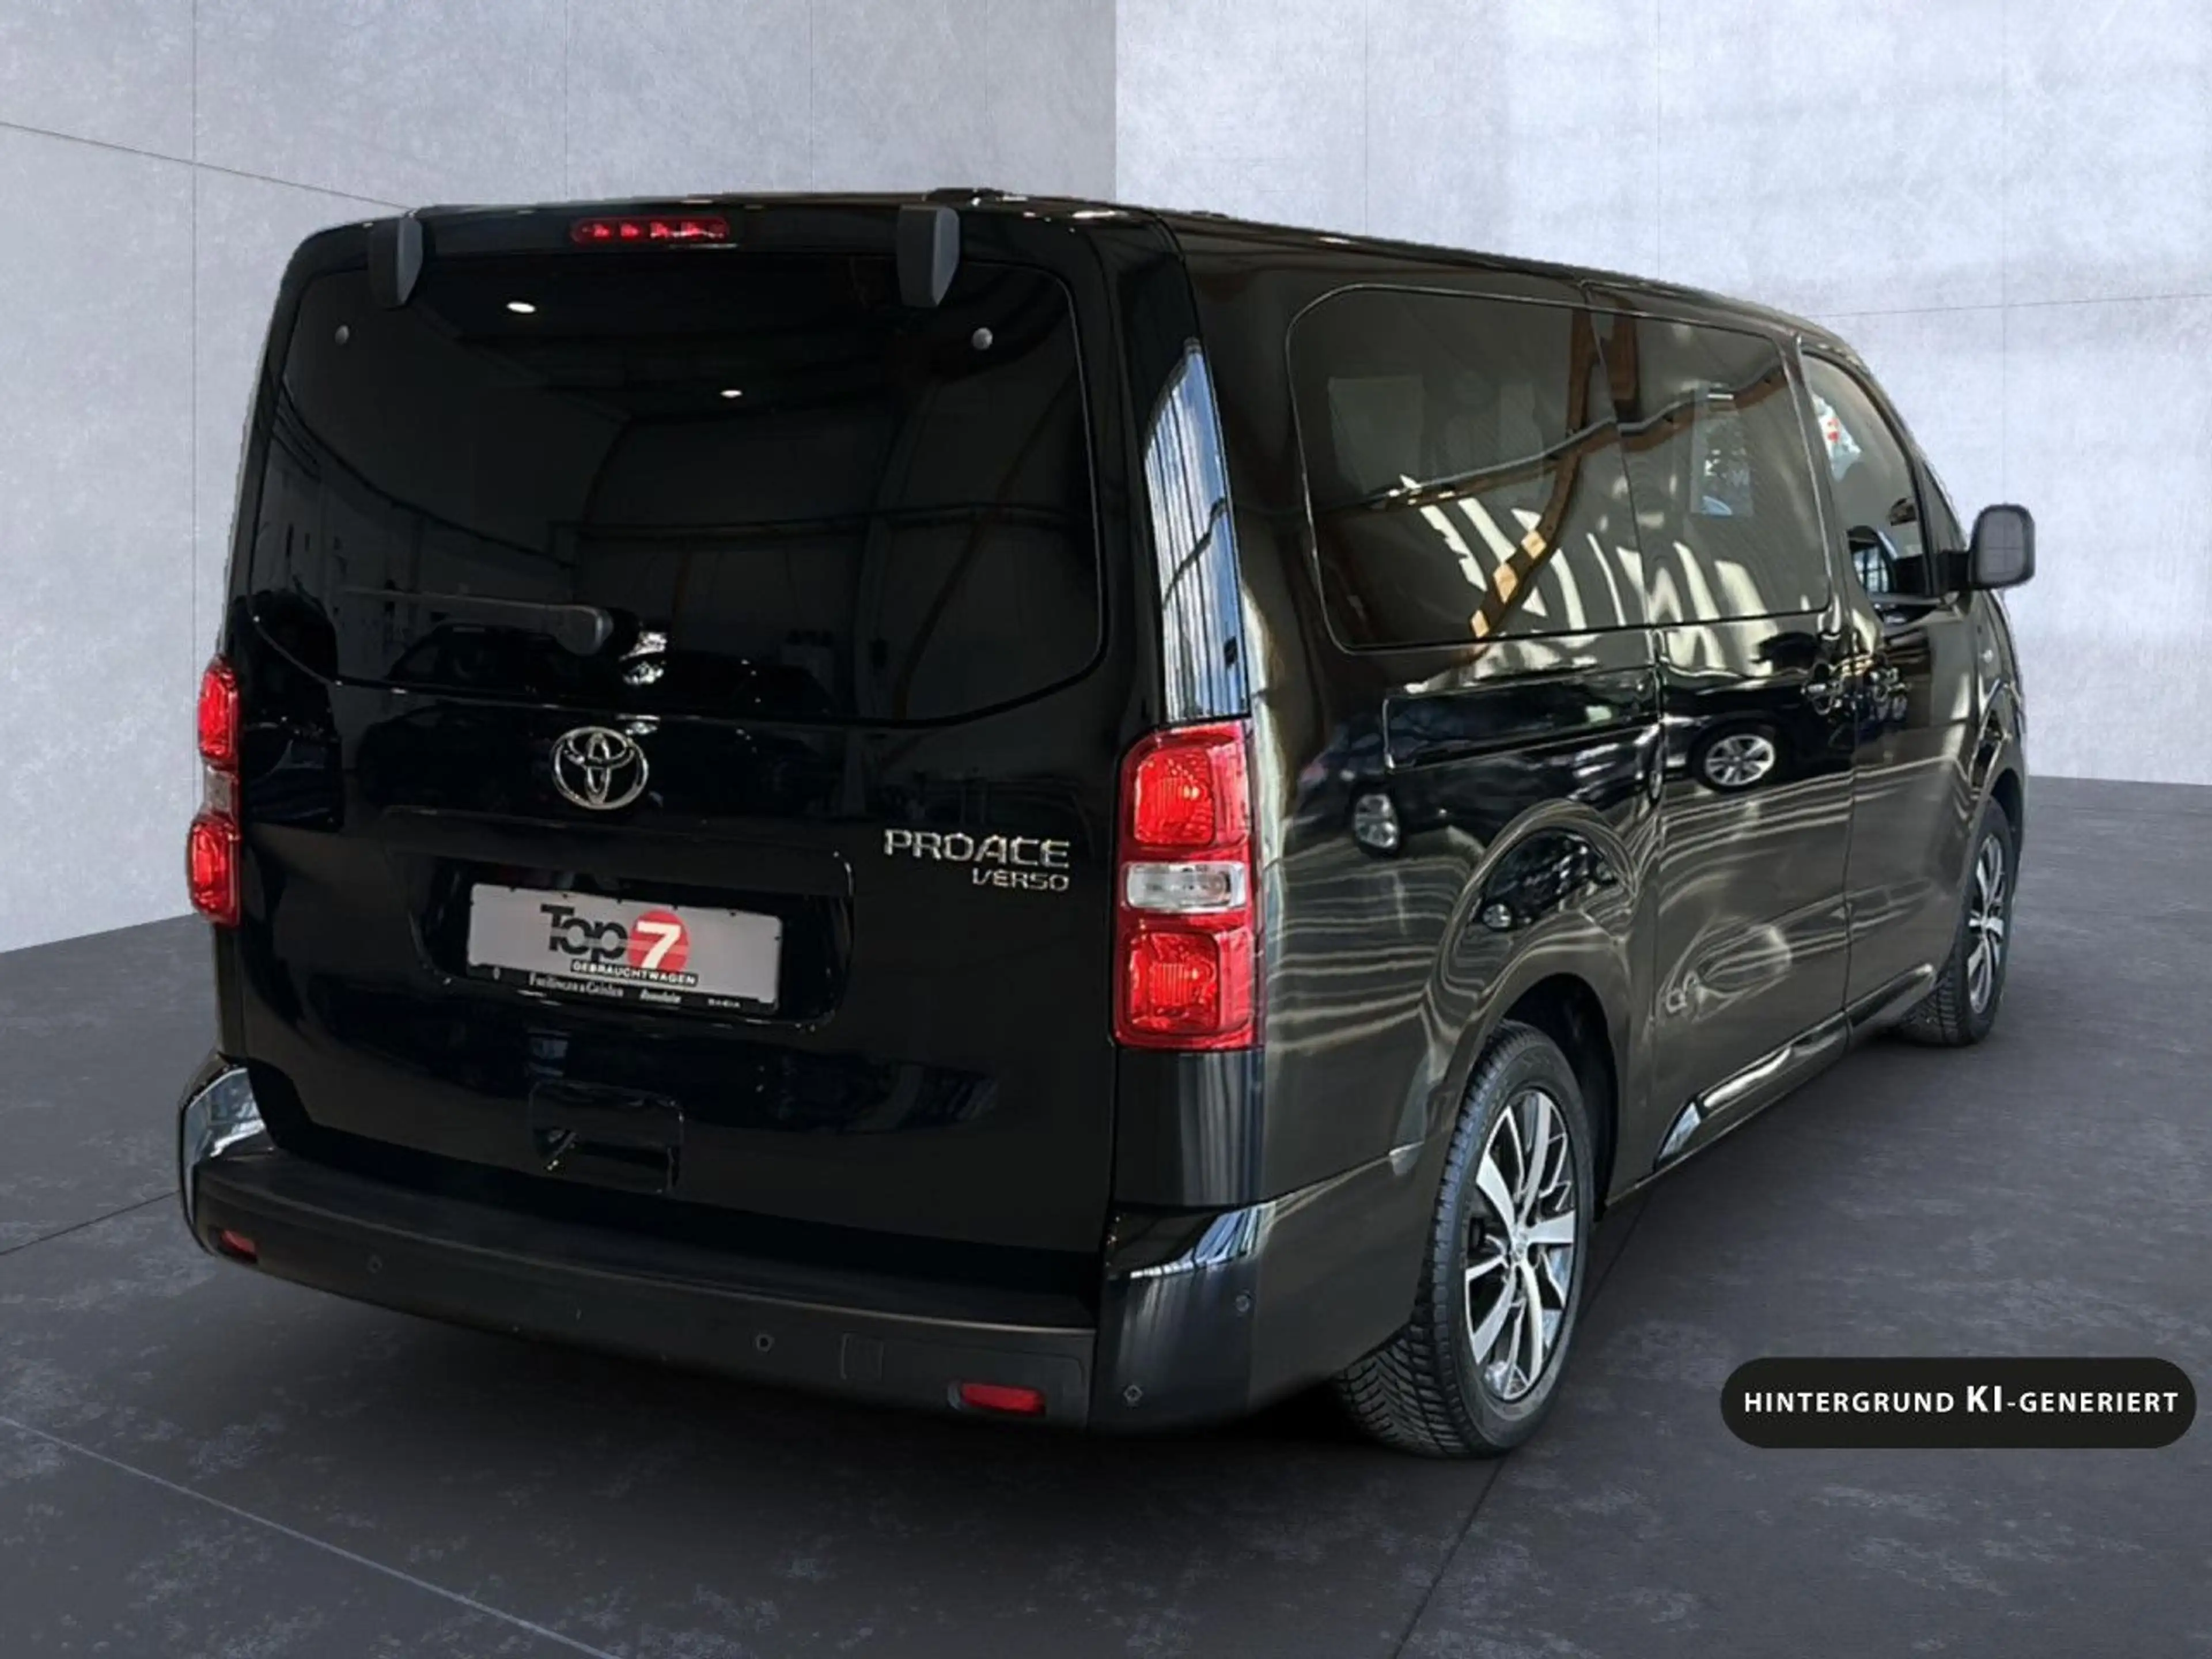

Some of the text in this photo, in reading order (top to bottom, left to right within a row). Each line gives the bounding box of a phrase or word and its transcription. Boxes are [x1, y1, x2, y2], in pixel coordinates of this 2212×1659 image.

[884, 828, 1070, 869] PROACE
[972, 867, 1070, 892] VERSO
[573, 961, 696, 985] GEBRAUCHTWAGEN
